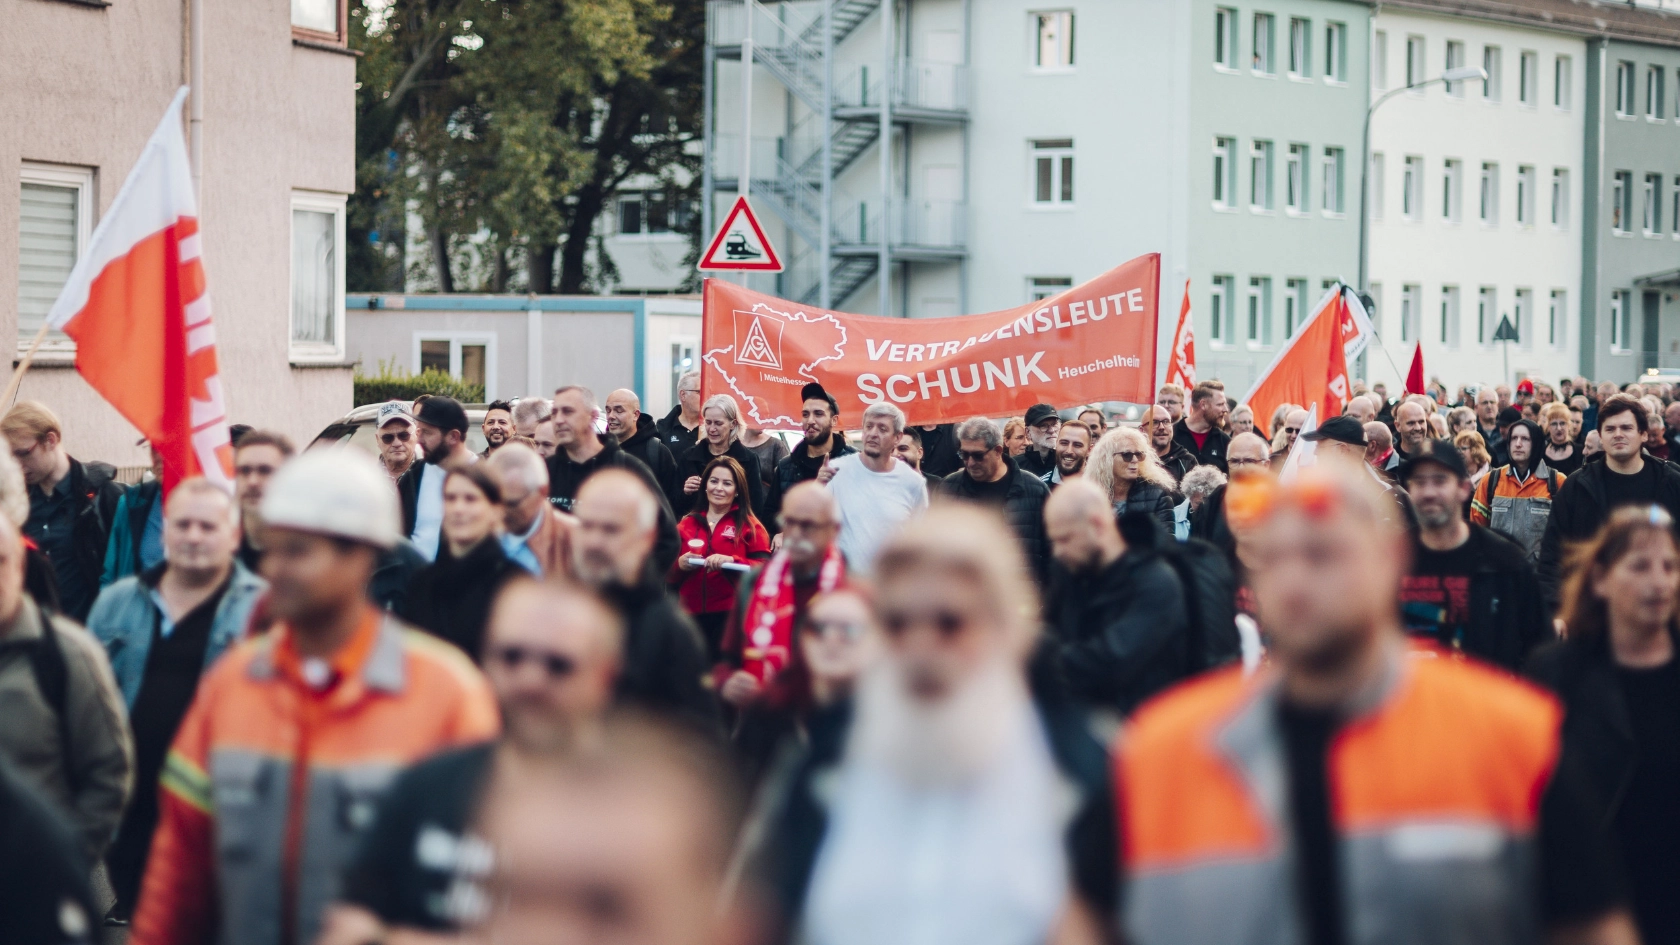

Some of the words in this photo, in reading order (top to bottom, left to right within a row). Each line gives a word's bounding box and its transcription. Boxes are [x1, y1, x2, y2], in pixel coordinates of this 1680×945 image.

[866, 288, 1144, 362] VERTRAUENSLEUTE
[856, 351, 1051, 405] SCHUNK
[1058, 354, 1141, 379] Heuchelheim
